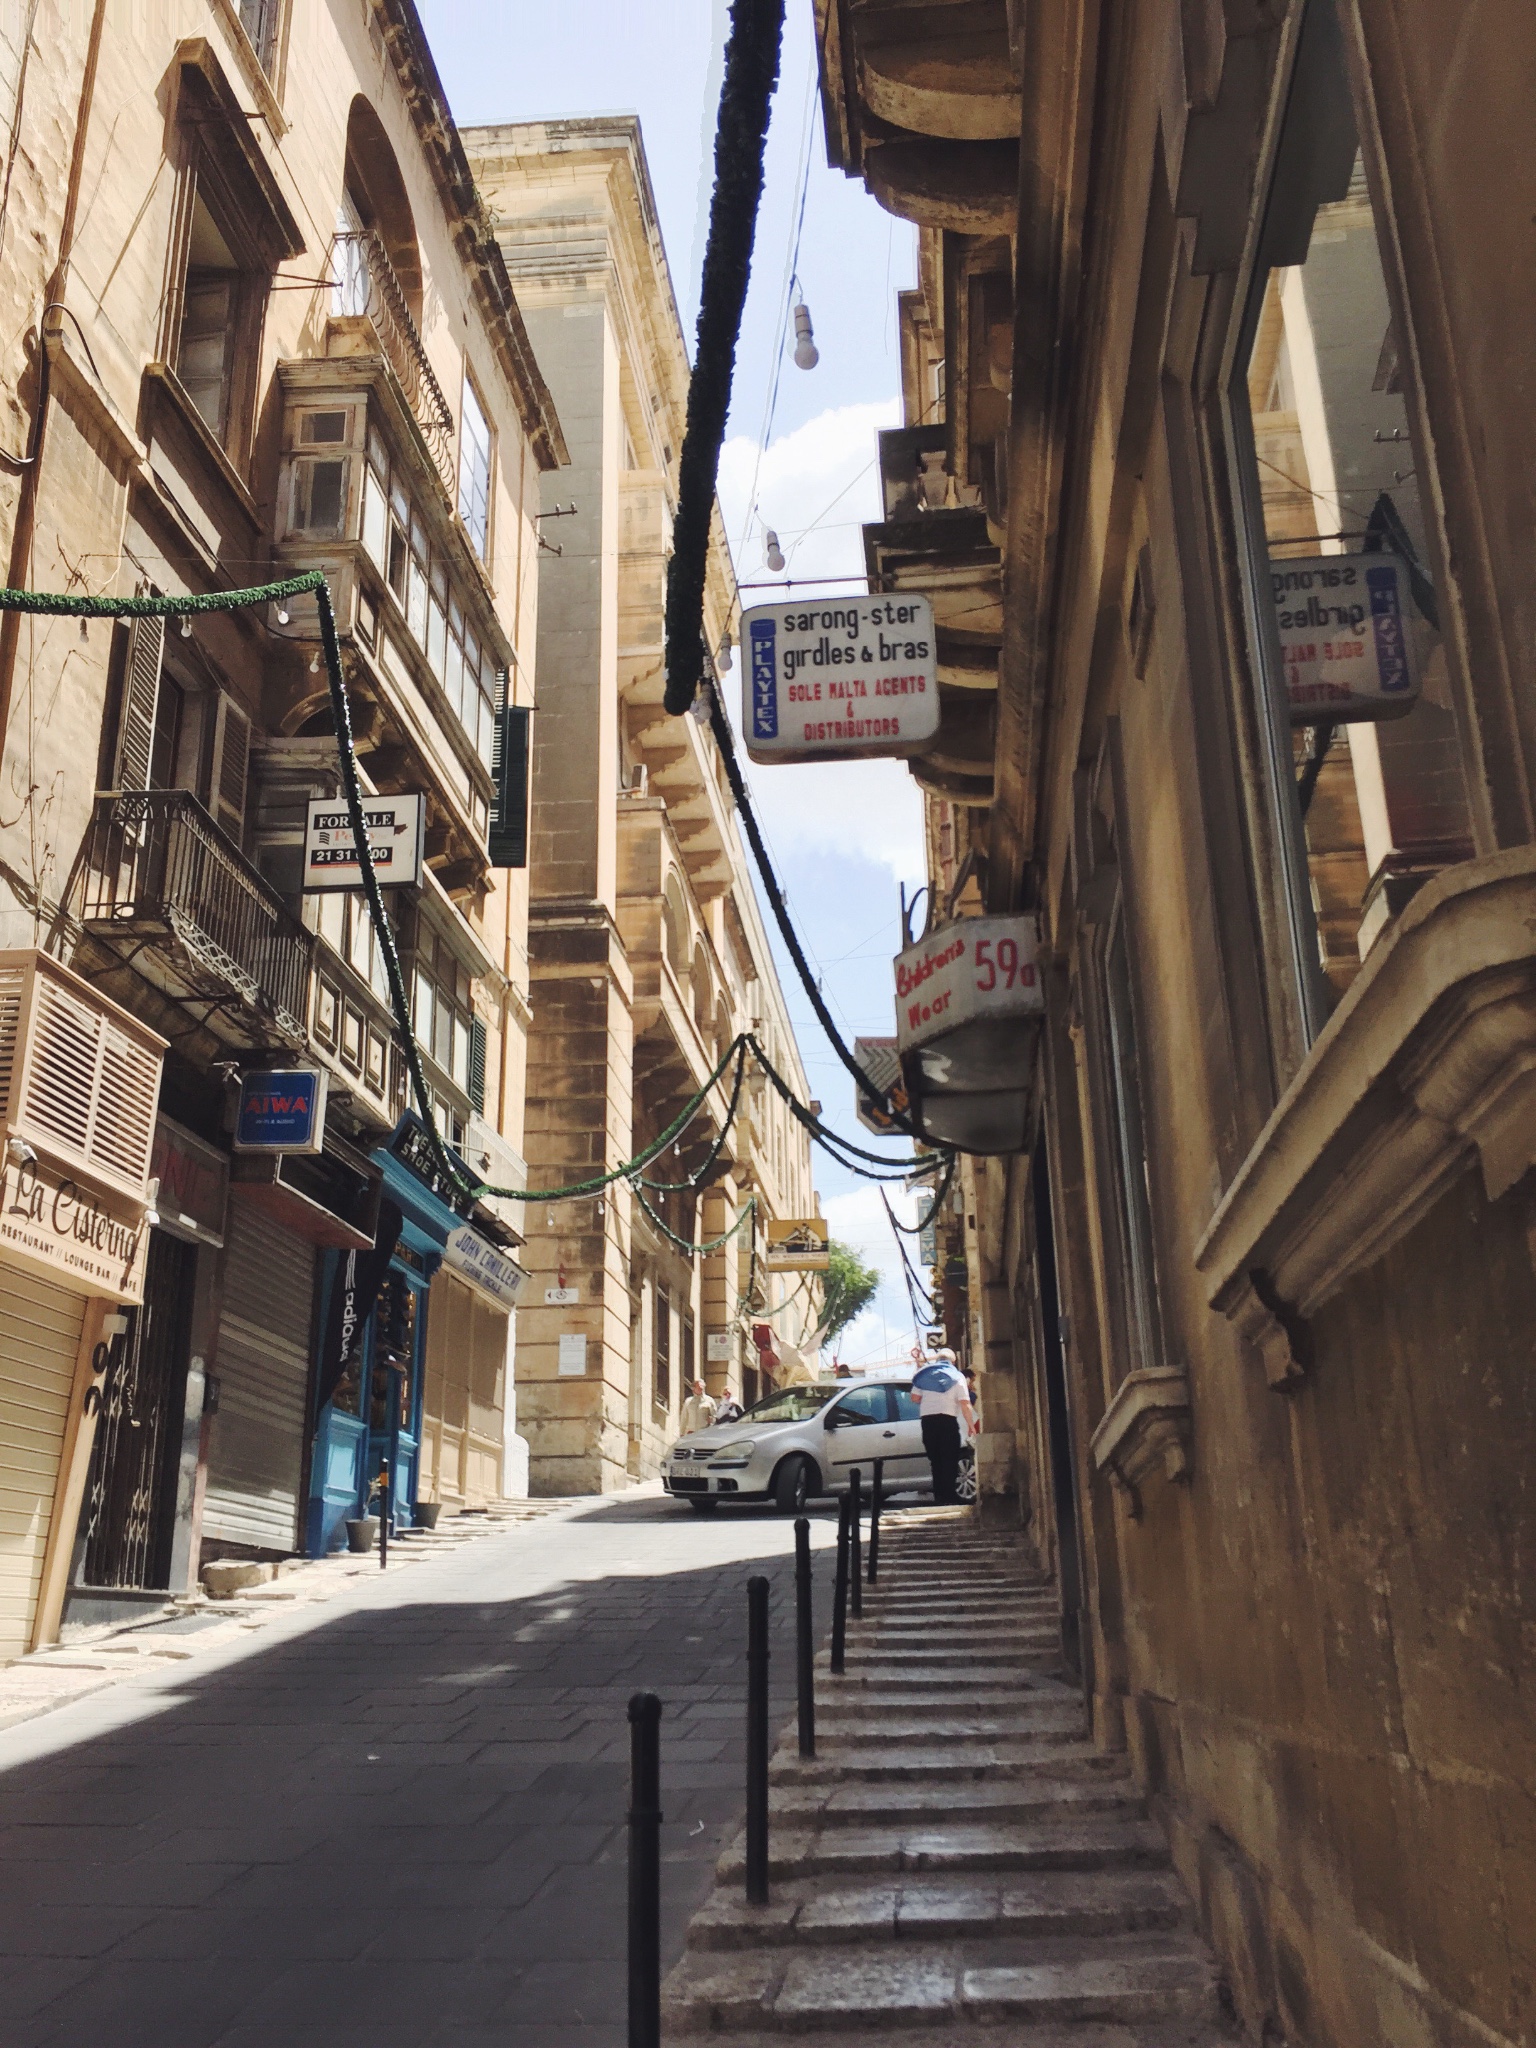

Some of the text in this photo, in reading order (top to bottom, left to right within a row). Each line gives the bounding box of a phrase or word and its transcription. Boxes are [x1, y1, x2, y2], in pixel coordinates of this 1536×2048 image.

[784, 601, 921, 639] sarong-ster
[783, 633, 929, 680] girdles & bras
[754, 640, 774, 733] PLAYTEX
[788, 682, 822, 702] SOLE
[829, 679, 868, 699] MALTA
[803, 717, 900, 741] DISTRIBUTORS
[319, 813, 392, 828] FOR ALE
[316, 850, 332, 862] 21
[336, 849, 351, 861] 31
[908, 989, 951, 1030] Wear
[245, 1096, 308, 1114] AIWA
[8, 1155, 139, 1264] La Cisterna
[1, 1222, 54, 1255] RESTAURANT
[64, 1251, 94, 1273] LOUNGE
[97, 1265, 110, 1280] BAR
[455, 1232, 481, 1261] JOHN
